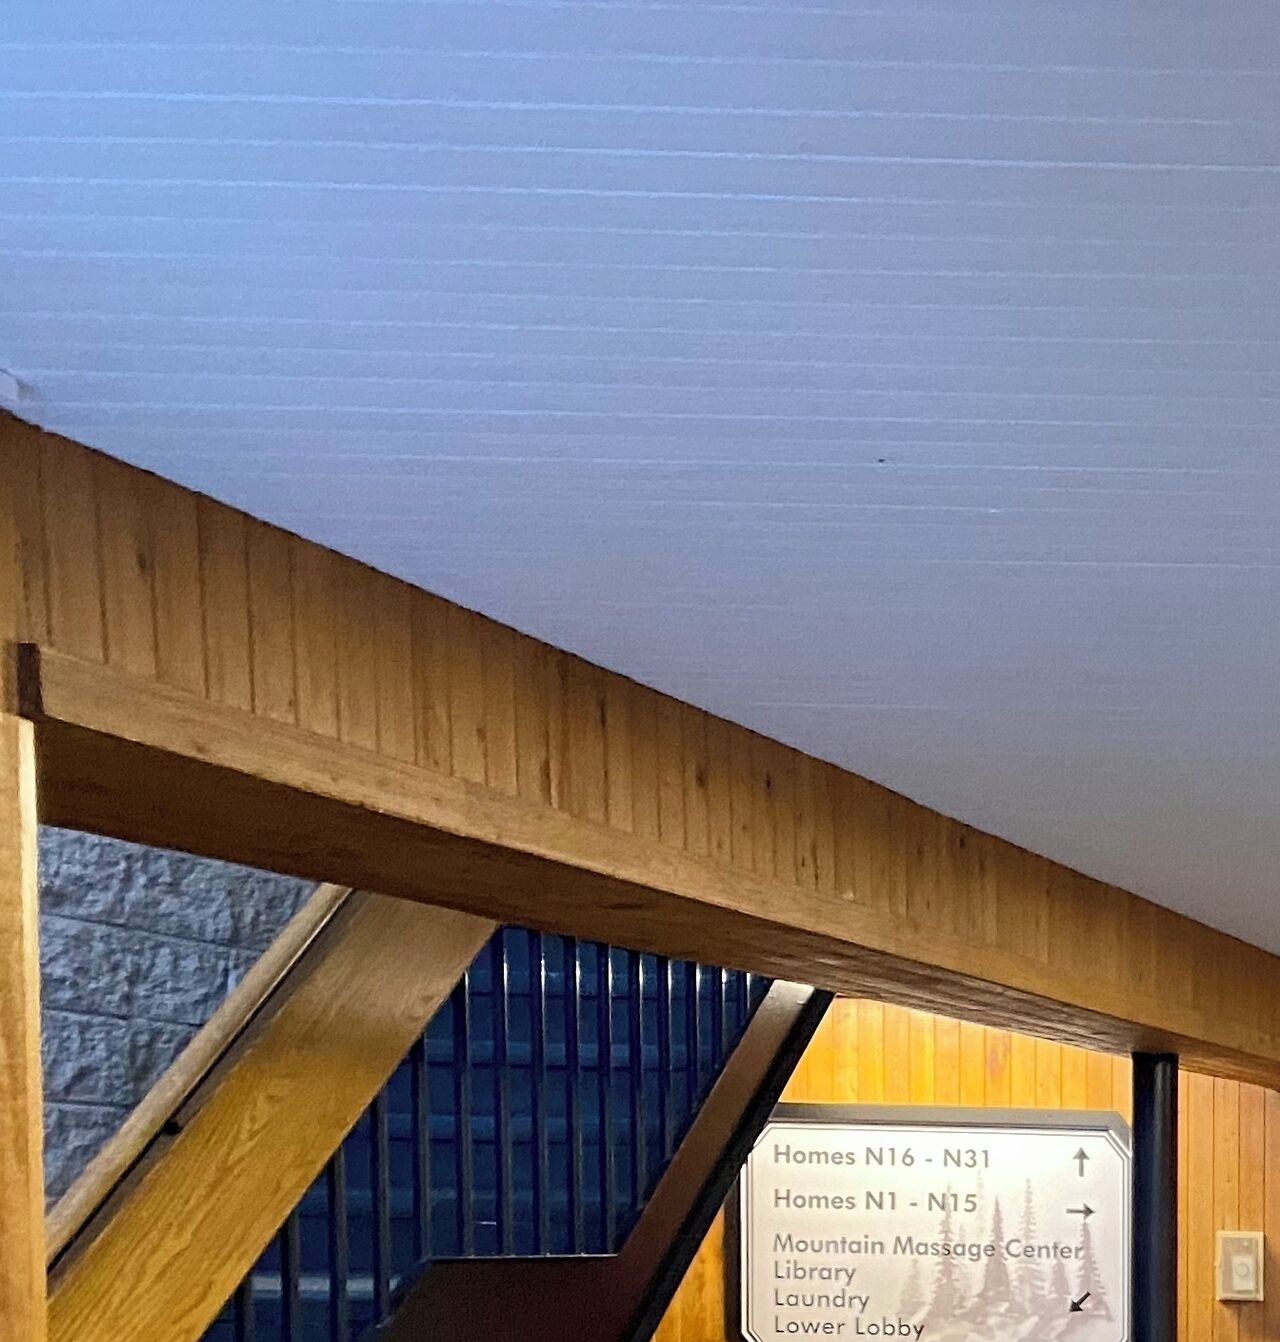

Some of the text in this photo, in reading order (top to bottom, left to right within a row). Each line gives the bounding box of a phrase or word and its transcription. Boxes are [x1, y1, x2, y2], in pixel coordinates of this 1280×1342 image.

[773, 1144, 856, 1166] Homes
[865, 1147, 915, 1167] N16
[943, 1149, 991, 1169] N31
[773, 1189, 856, 1210] Homes
[865, 1191, 896, 1211] N1
[927, 1193, 978, 1213] N15
[773, 1234, 1084, 1262] Mountain Massage Center
[774, 1260, 857, 1285] Library
[774, 1288, 870, 1313] Laundry
[774, 1316, 926, 1341] Lower Lobby
